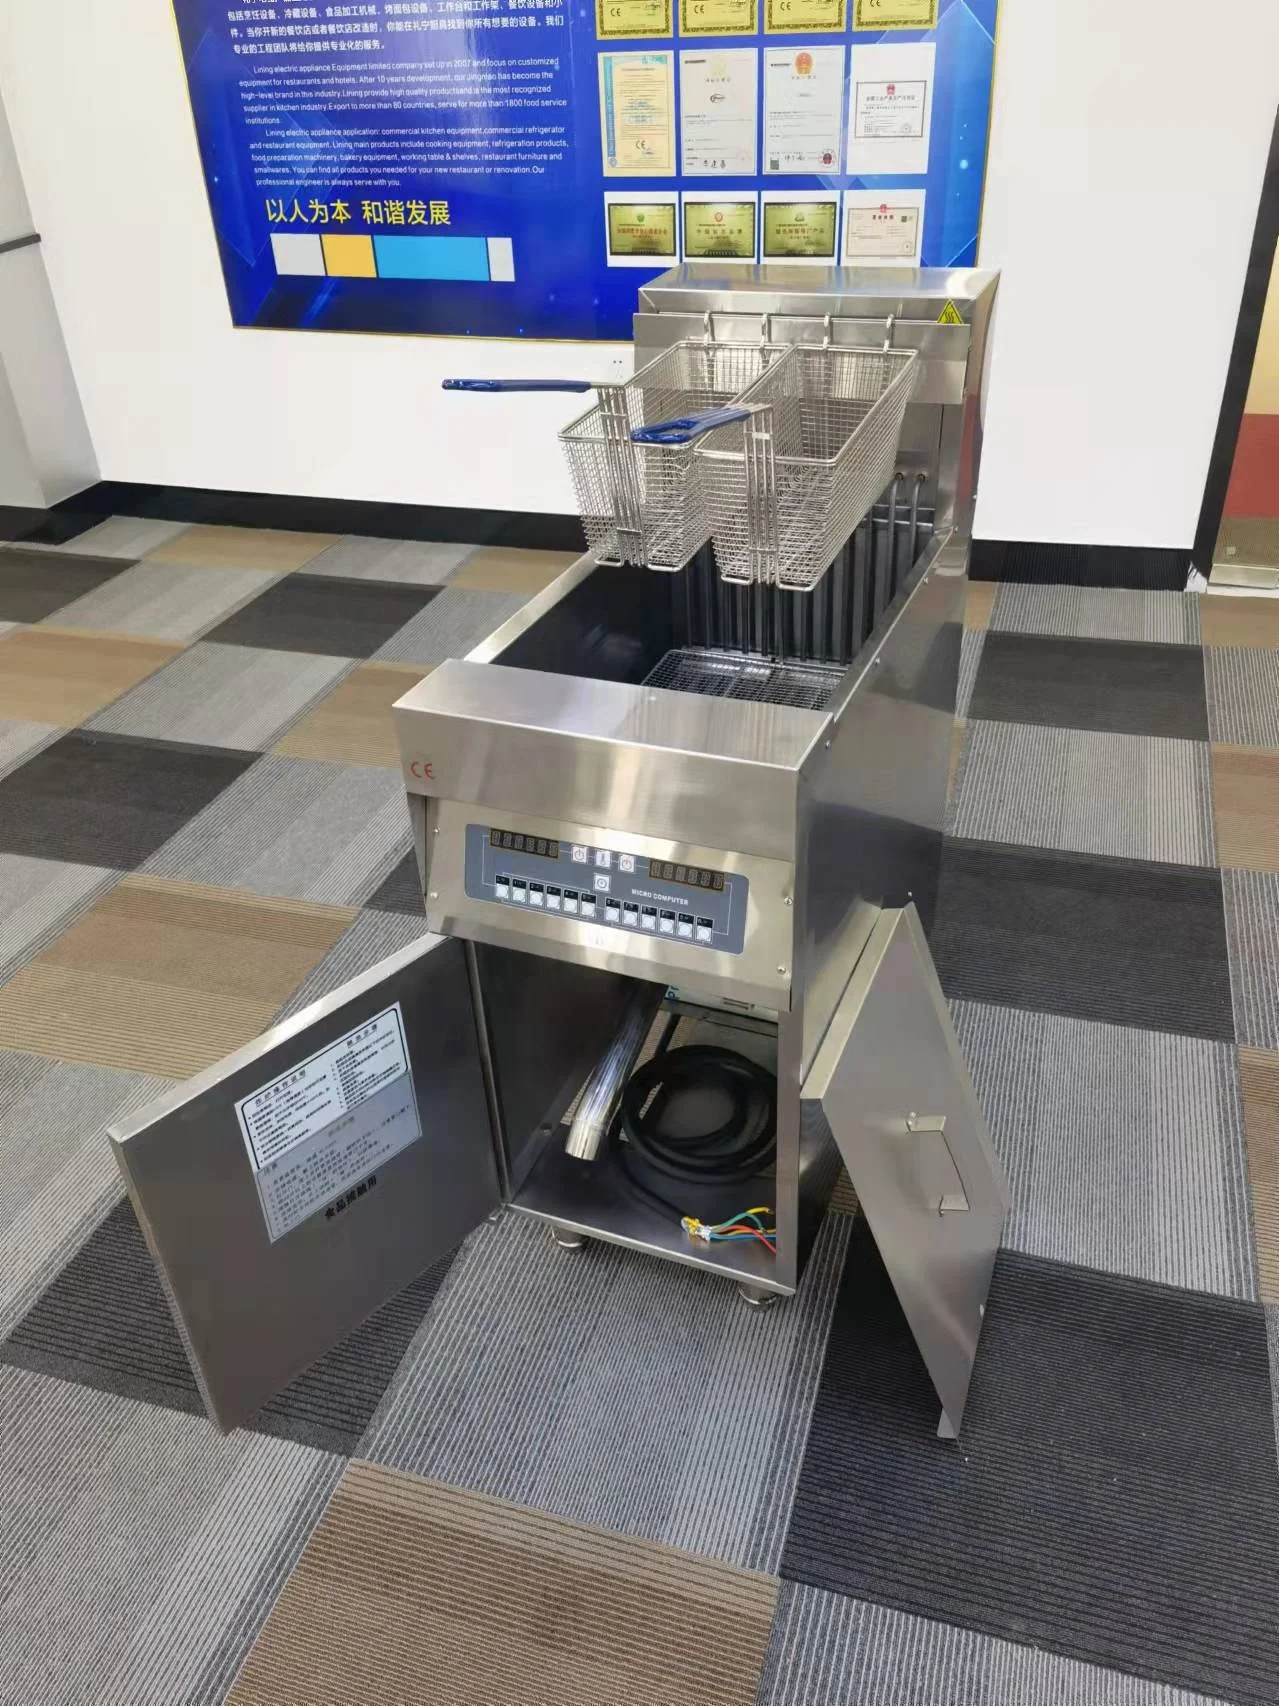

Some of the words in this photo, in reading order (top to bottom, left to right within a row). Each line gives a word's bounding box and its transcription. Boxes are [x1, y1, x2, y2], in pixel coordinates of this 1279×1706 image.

[265, 198, 351, 224] 以人为本
[361, 199, 451, 226] 和谐发展
[410, 760, 437, 780] CE
[631, 888, 652, 898] MICRO
[653, 893, 689, 906] COMPUTER
